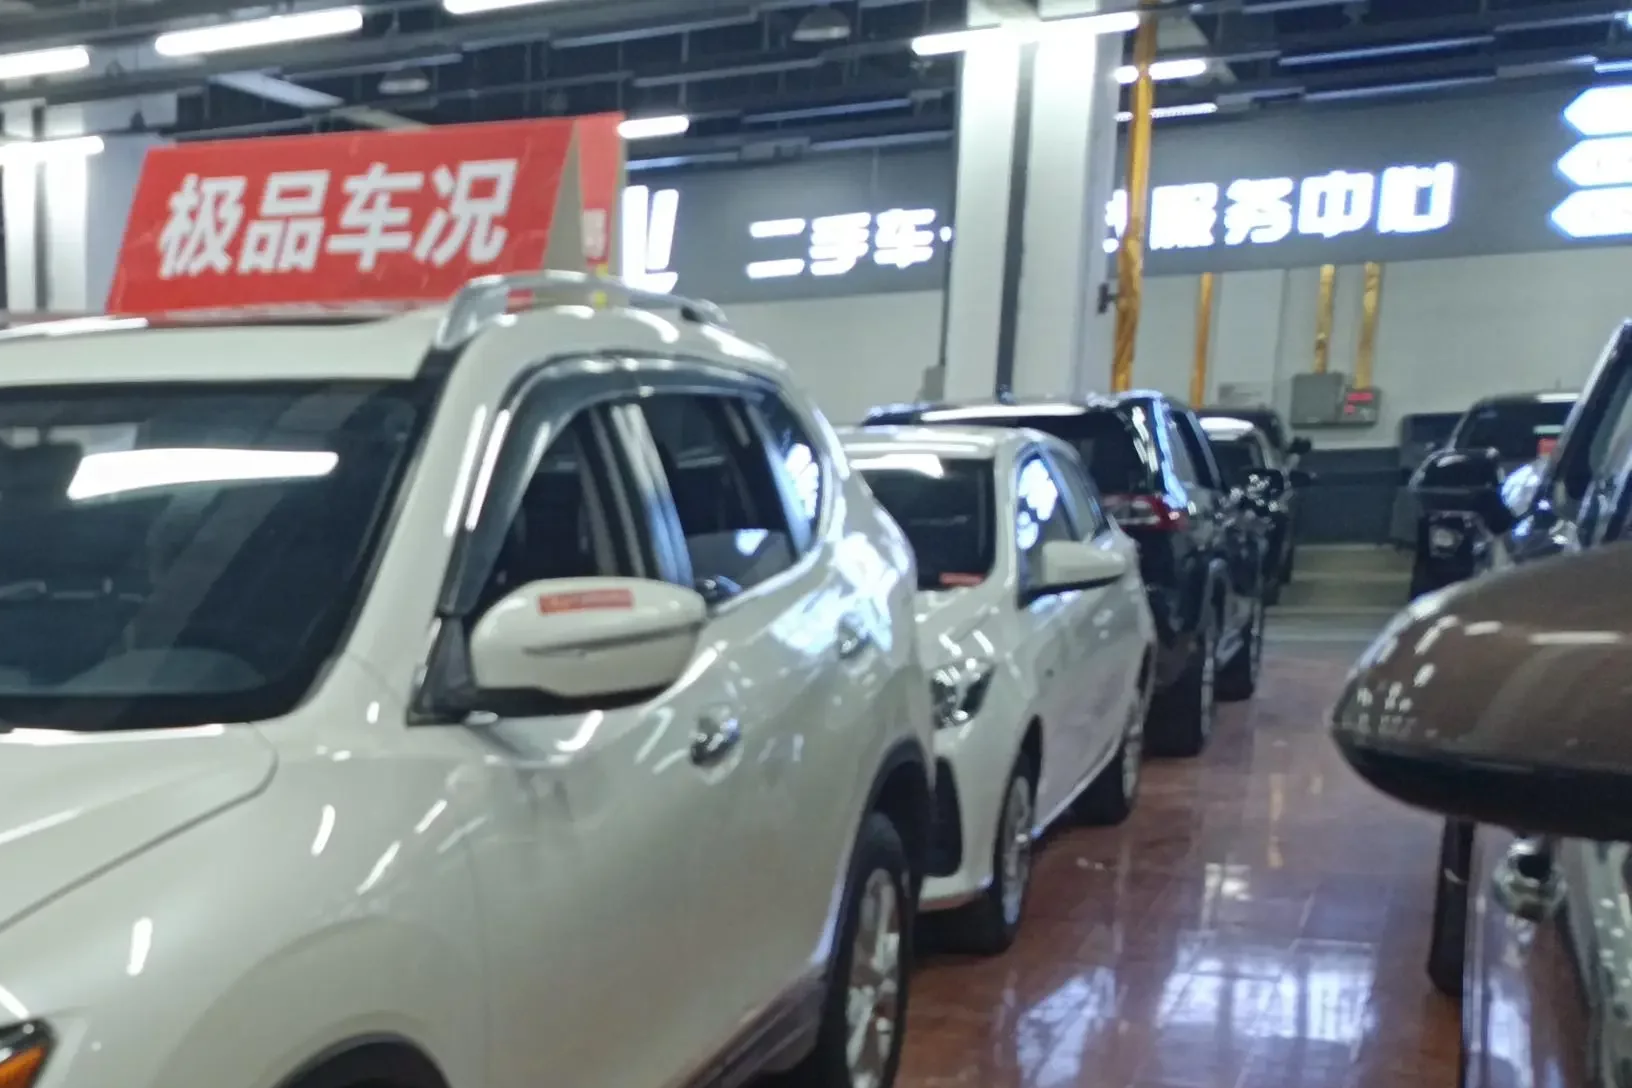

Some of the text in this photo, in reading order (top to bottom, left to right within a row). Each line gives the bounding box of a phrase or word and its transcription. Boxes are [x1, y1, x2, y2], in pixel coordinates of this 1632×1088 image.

[158, 158, 518, 279] 极品车况
[745, 207, 952, 279] 二手车
